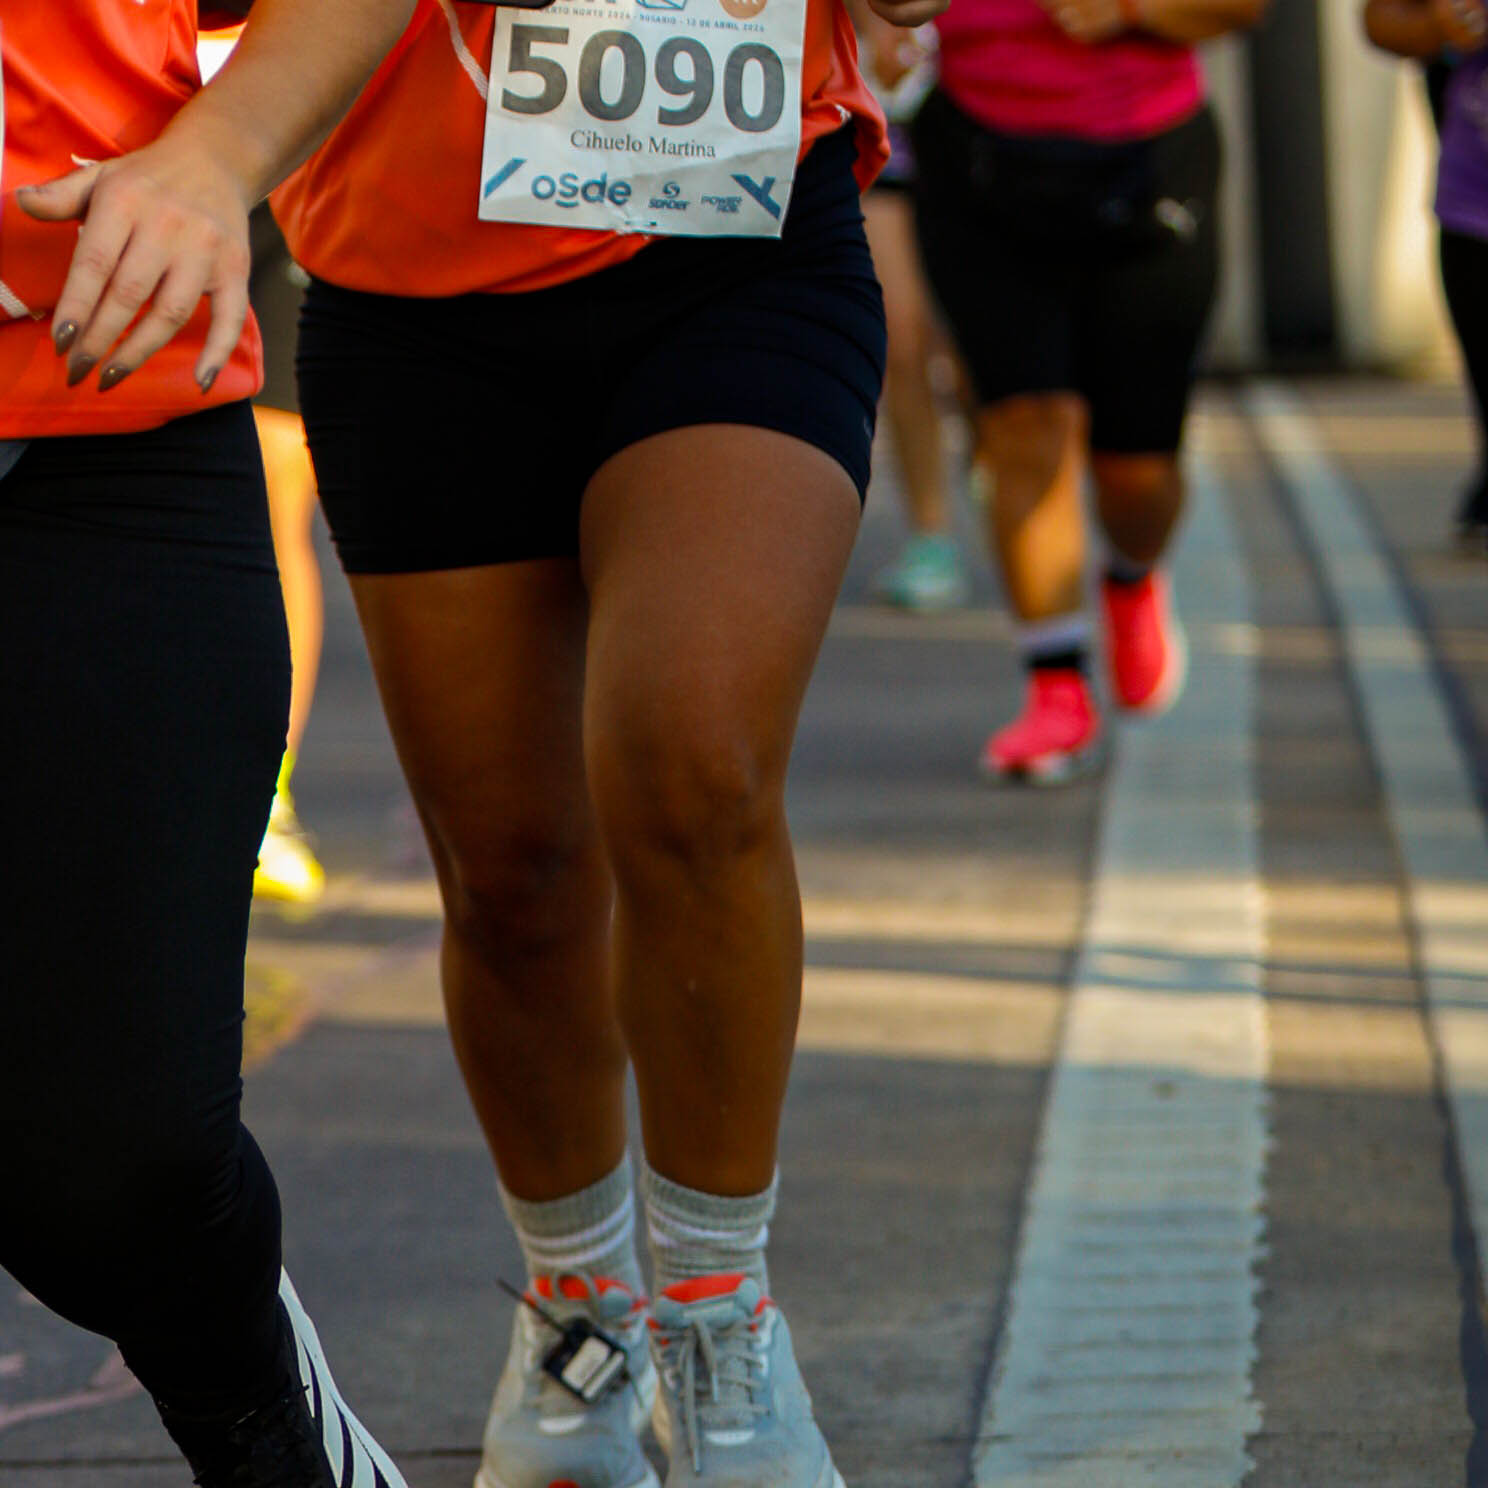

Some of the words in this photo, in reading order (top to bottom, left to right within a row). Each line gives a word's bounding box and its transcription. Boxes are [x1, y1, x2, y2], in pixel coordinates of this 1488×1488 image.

[501, 23, 785, 133] 5090
[570, 129, 642, 152] Cihuelo
[648, 136, 716, 158] Martina
[531, 171, 632, 208] osde
